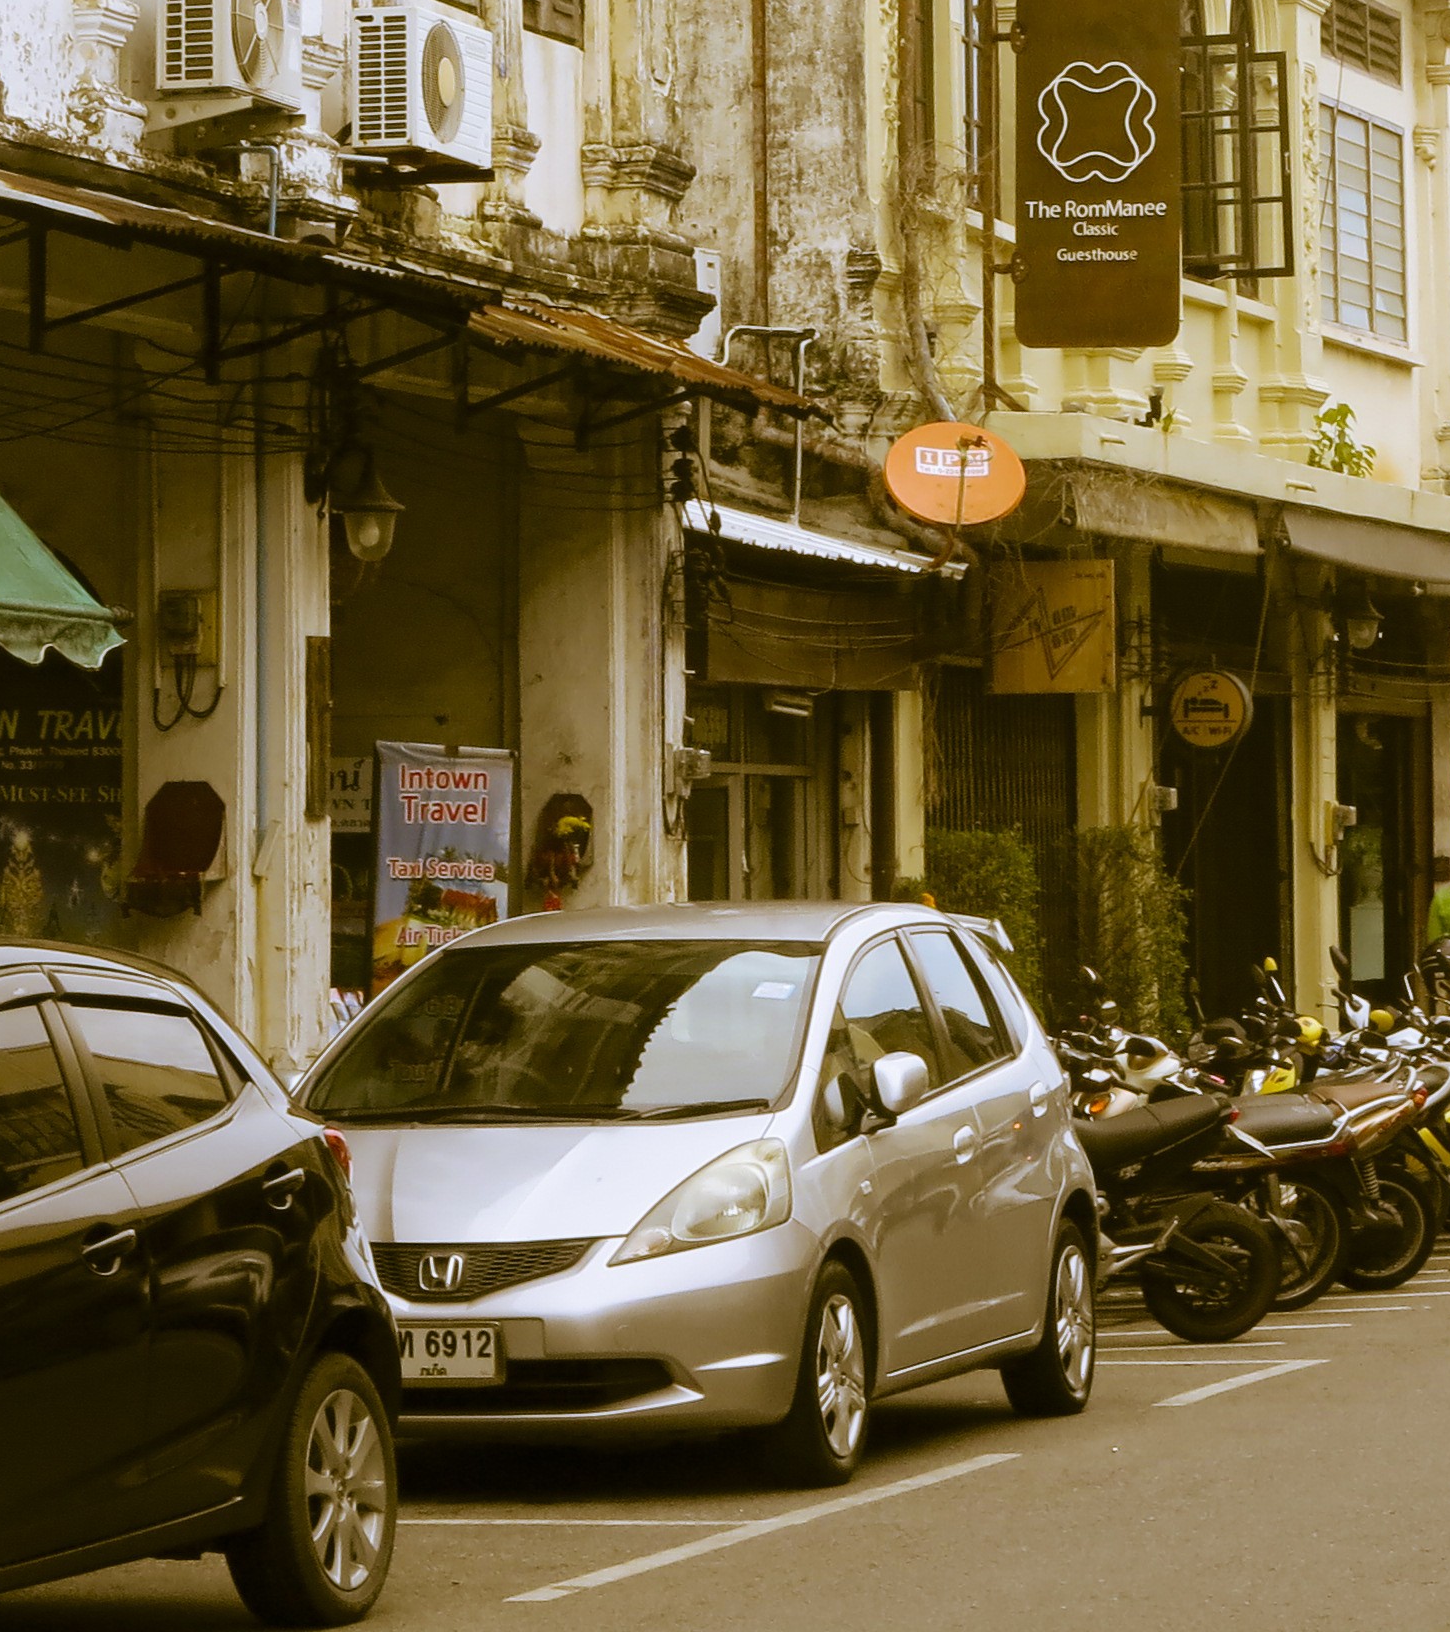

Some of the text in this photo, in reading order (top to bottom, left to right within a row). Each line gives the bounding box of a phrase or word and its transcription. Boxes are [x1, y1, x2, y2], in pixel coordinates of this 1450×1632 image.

[1025, 199, 1167, 218] The RomManee
[1072, 221, 1119, 236] Classic
[1056, 248, 1138, 262] Guesthouse
[400, 764, 489, 790] Intown
[0, 783, 91, 803] MUST-SEE
[401, 795, 488, 822] Travel
[387, 858, 494, 880] Taxi Service
[397, 927, 422, 946] Air
[425, 1329, 492, 1358] 6912
